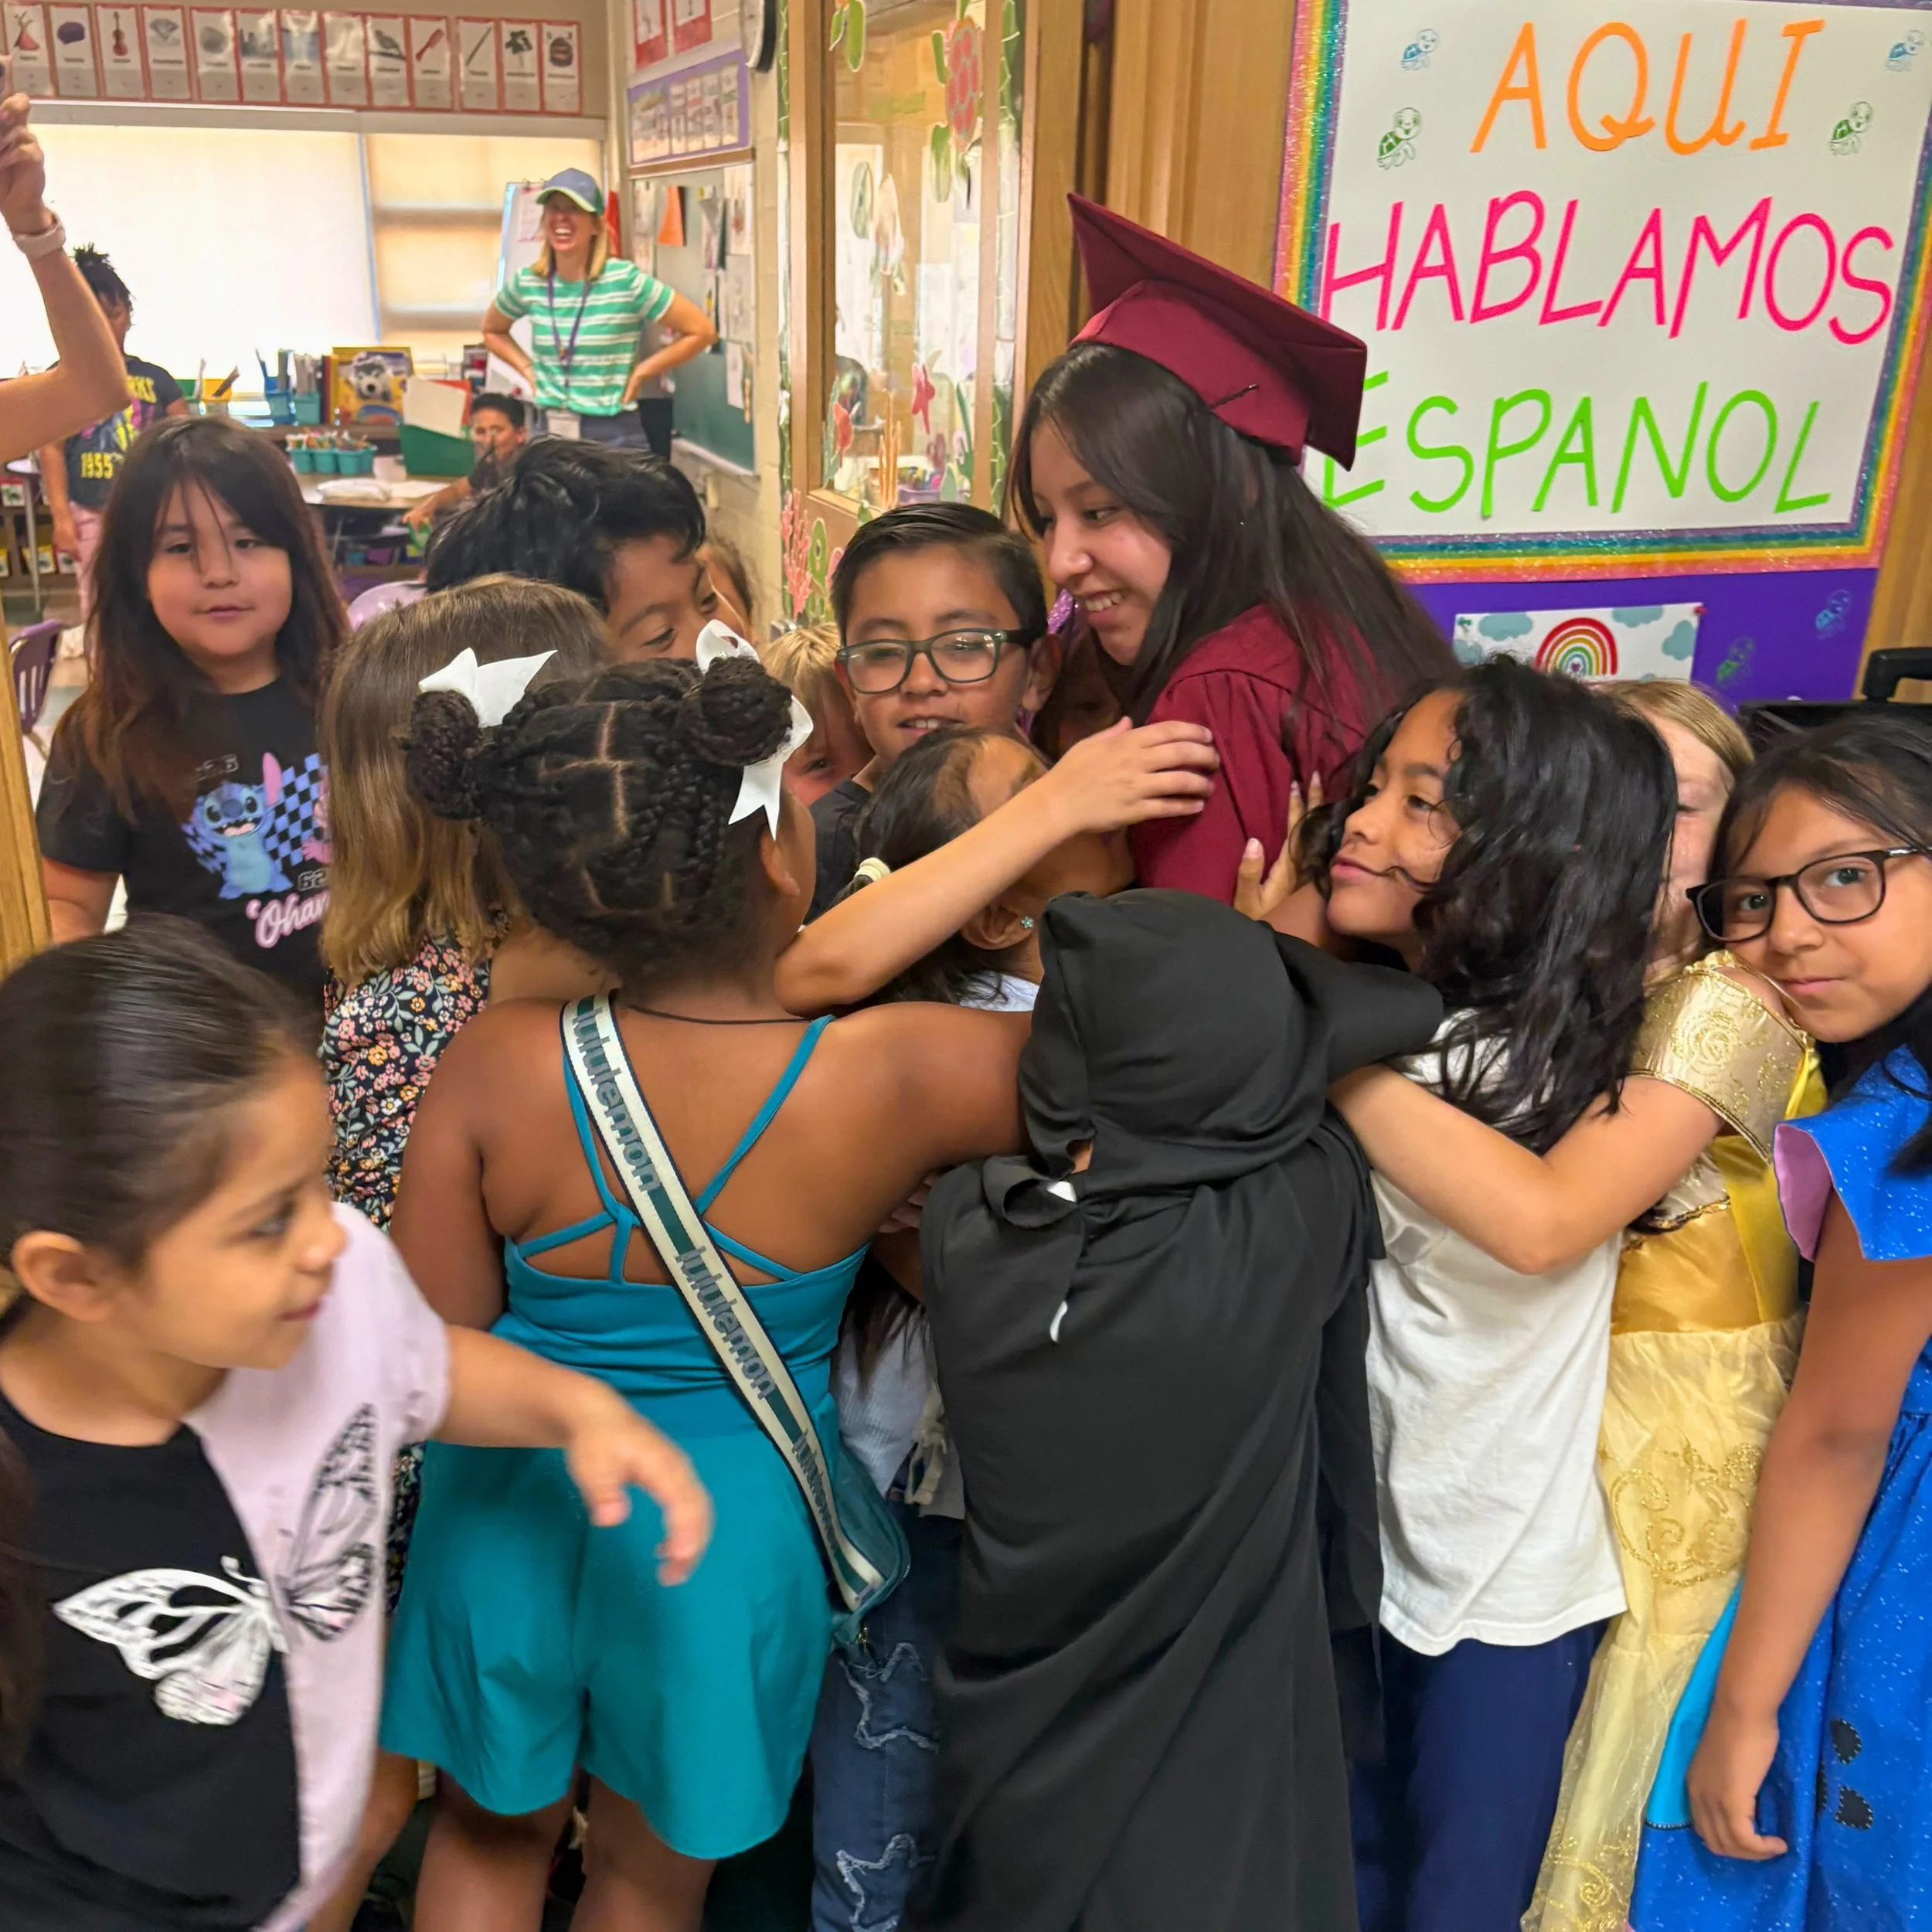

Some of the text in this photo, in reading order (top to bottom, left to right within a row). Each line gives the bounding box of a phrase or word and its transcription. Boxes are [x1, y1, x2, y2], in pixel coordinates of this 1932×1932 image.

[1470, 17, 1826, 157] AQUI
[1318, 189, 1895, 347] HABLAMOS
[1322, 370, 1832, 520] ESPANOL
[572, 1007, 661, 1192] lululemon
[675, 1245, 777, 1400] lululemon
